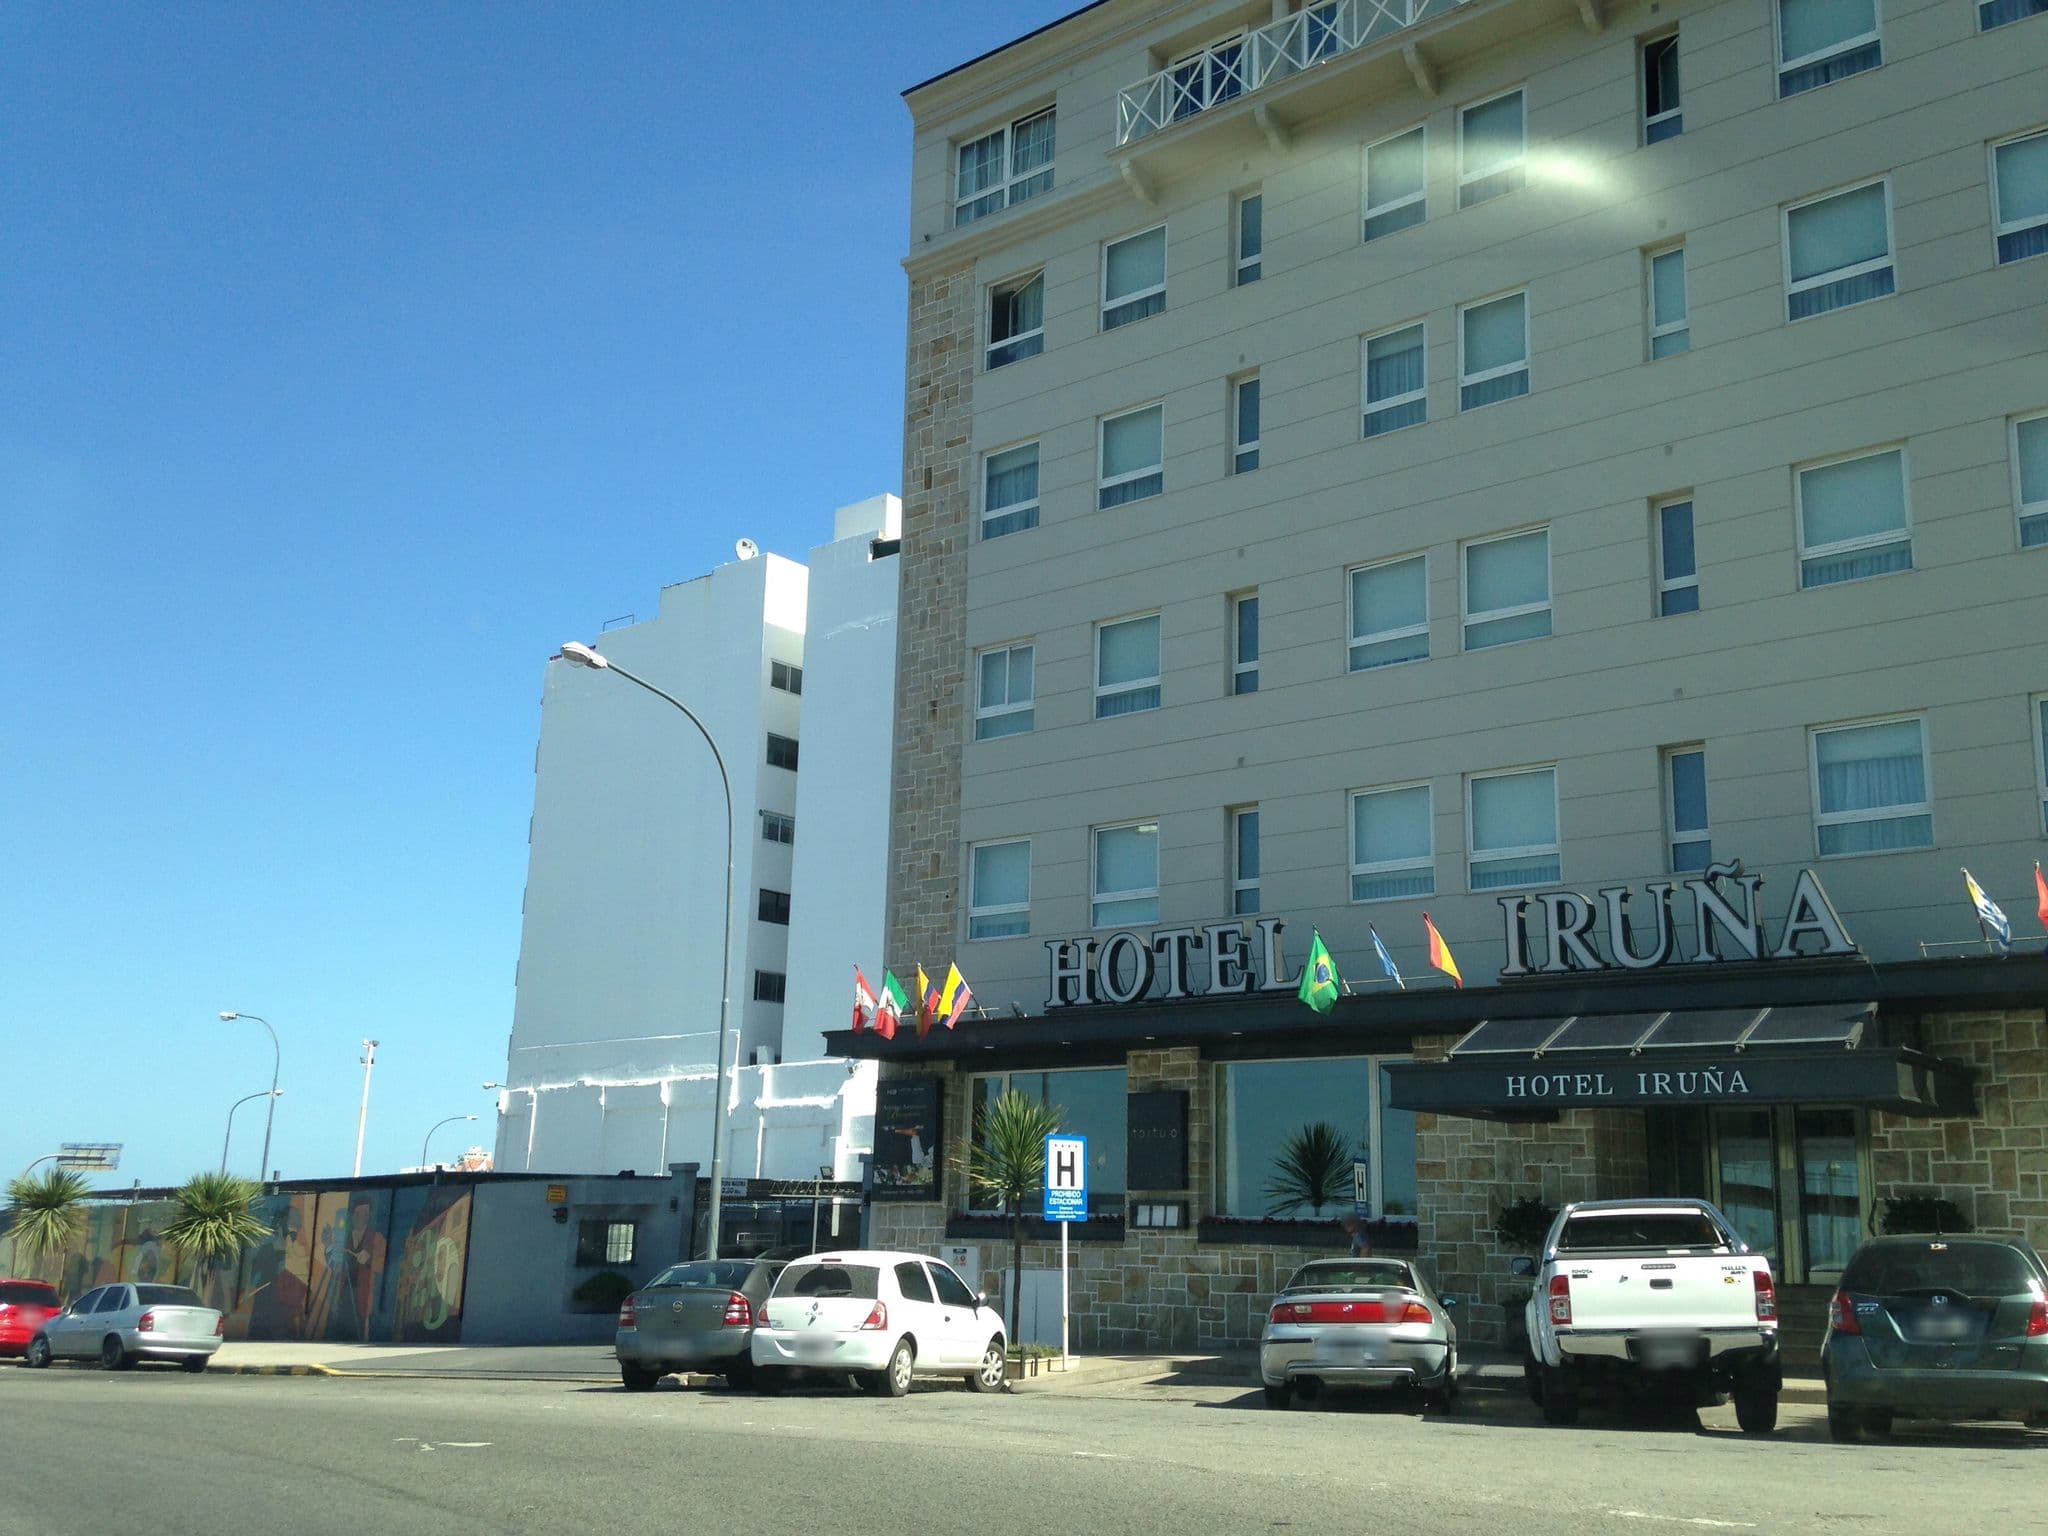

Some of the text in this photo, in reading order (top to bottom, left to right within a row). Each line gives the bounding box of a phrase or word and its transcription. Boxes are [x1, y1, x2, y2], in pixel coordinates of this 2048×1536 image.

[1044, 859, 1862, 1008] HOTEL IRUÑA
[1506, 1066, 1750, 1097] HOTEL IRUÑA
[1057, 1150, 1075, 1187] H
[1049, 1198, 1083, 1206] ESTACIONAR
[1051, 1190, 1082, 1198] PROHIBIDO
